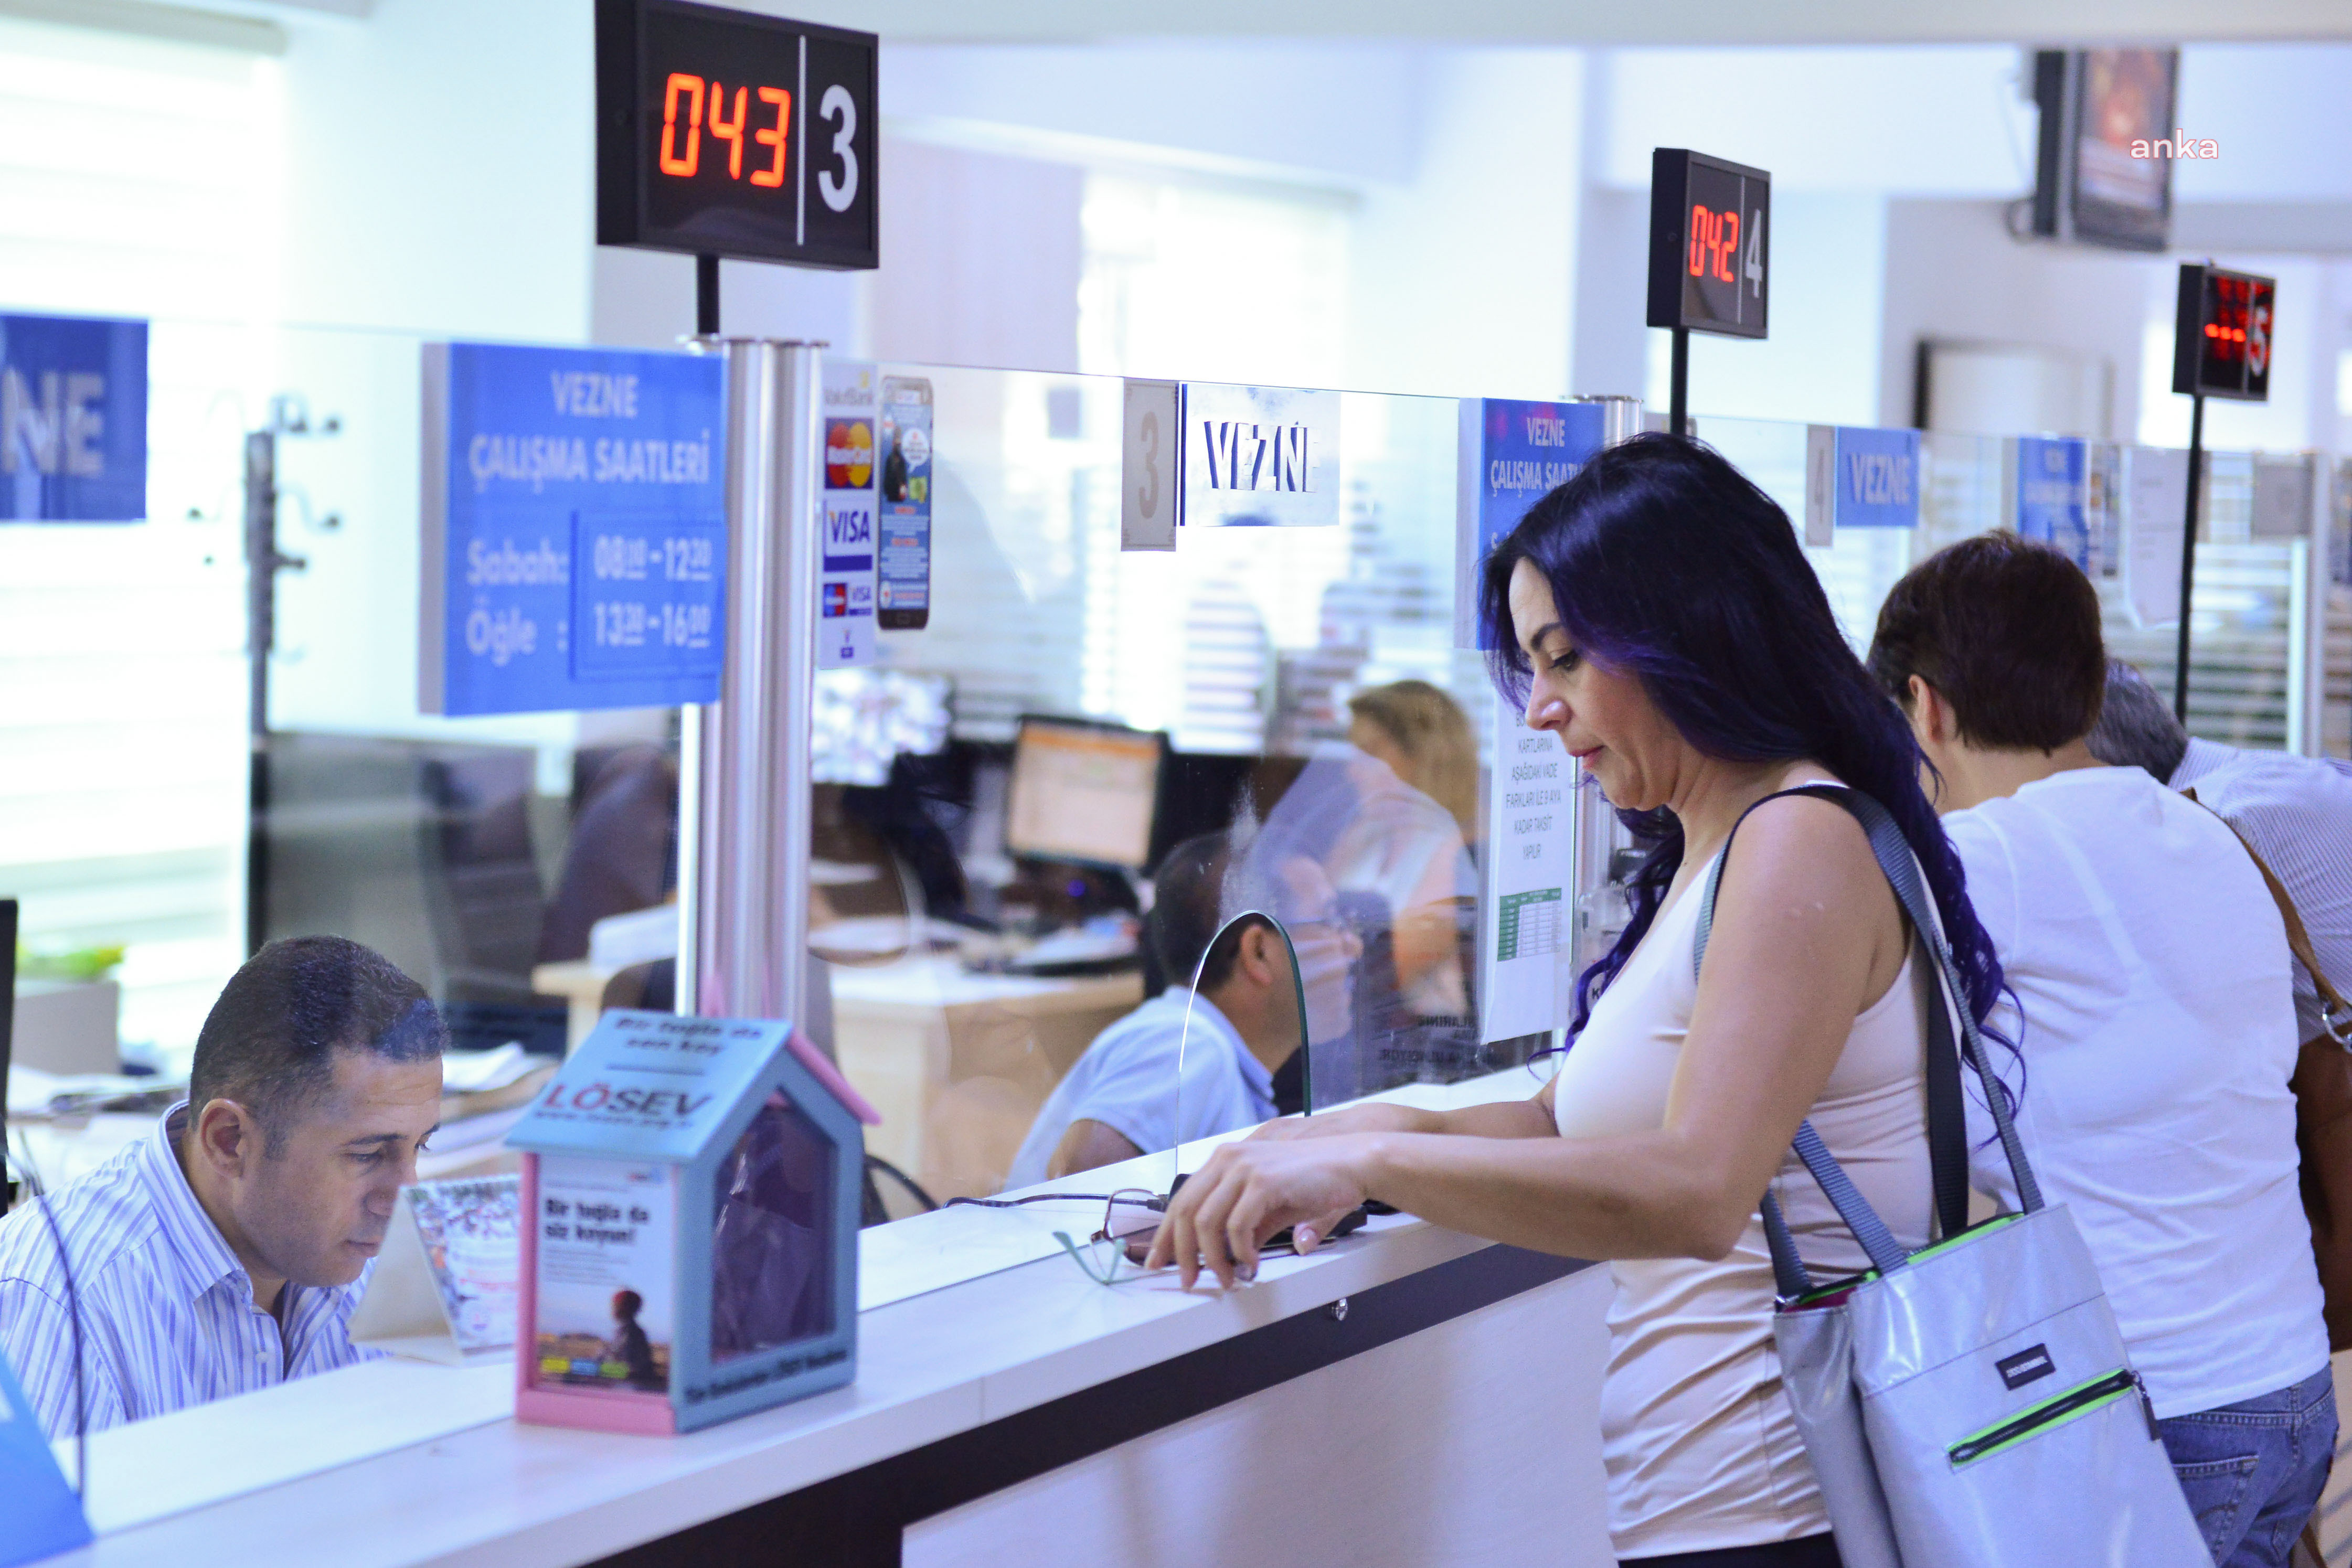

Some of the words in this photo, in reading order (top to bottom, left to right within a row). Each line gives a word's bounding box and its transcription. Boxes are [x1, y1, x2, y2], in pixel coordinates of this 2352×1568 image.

[660, 72, 791, 188] 043
[818, 84, 858, 212] 3
[1689, 205, 1739, 282] 042
[1746, 209, 1762, 298] 4
[551, 370, 639, 419] VEZNE
[1527, 417, 1566, 447] VEZNE
[470, 434, 589, 494] ÇALIŞMA
[594, 428, 710, 484] SAATLERİ
[1139, 412, 1158, 519] 3
[1491, 460, 1542, 498] ÇALIŞMA
[1846, 453, 1910, 504] VEZNE
[829, 510, 871, 543] VISA
[543, 1082, 712, 1116] LÖSEV
